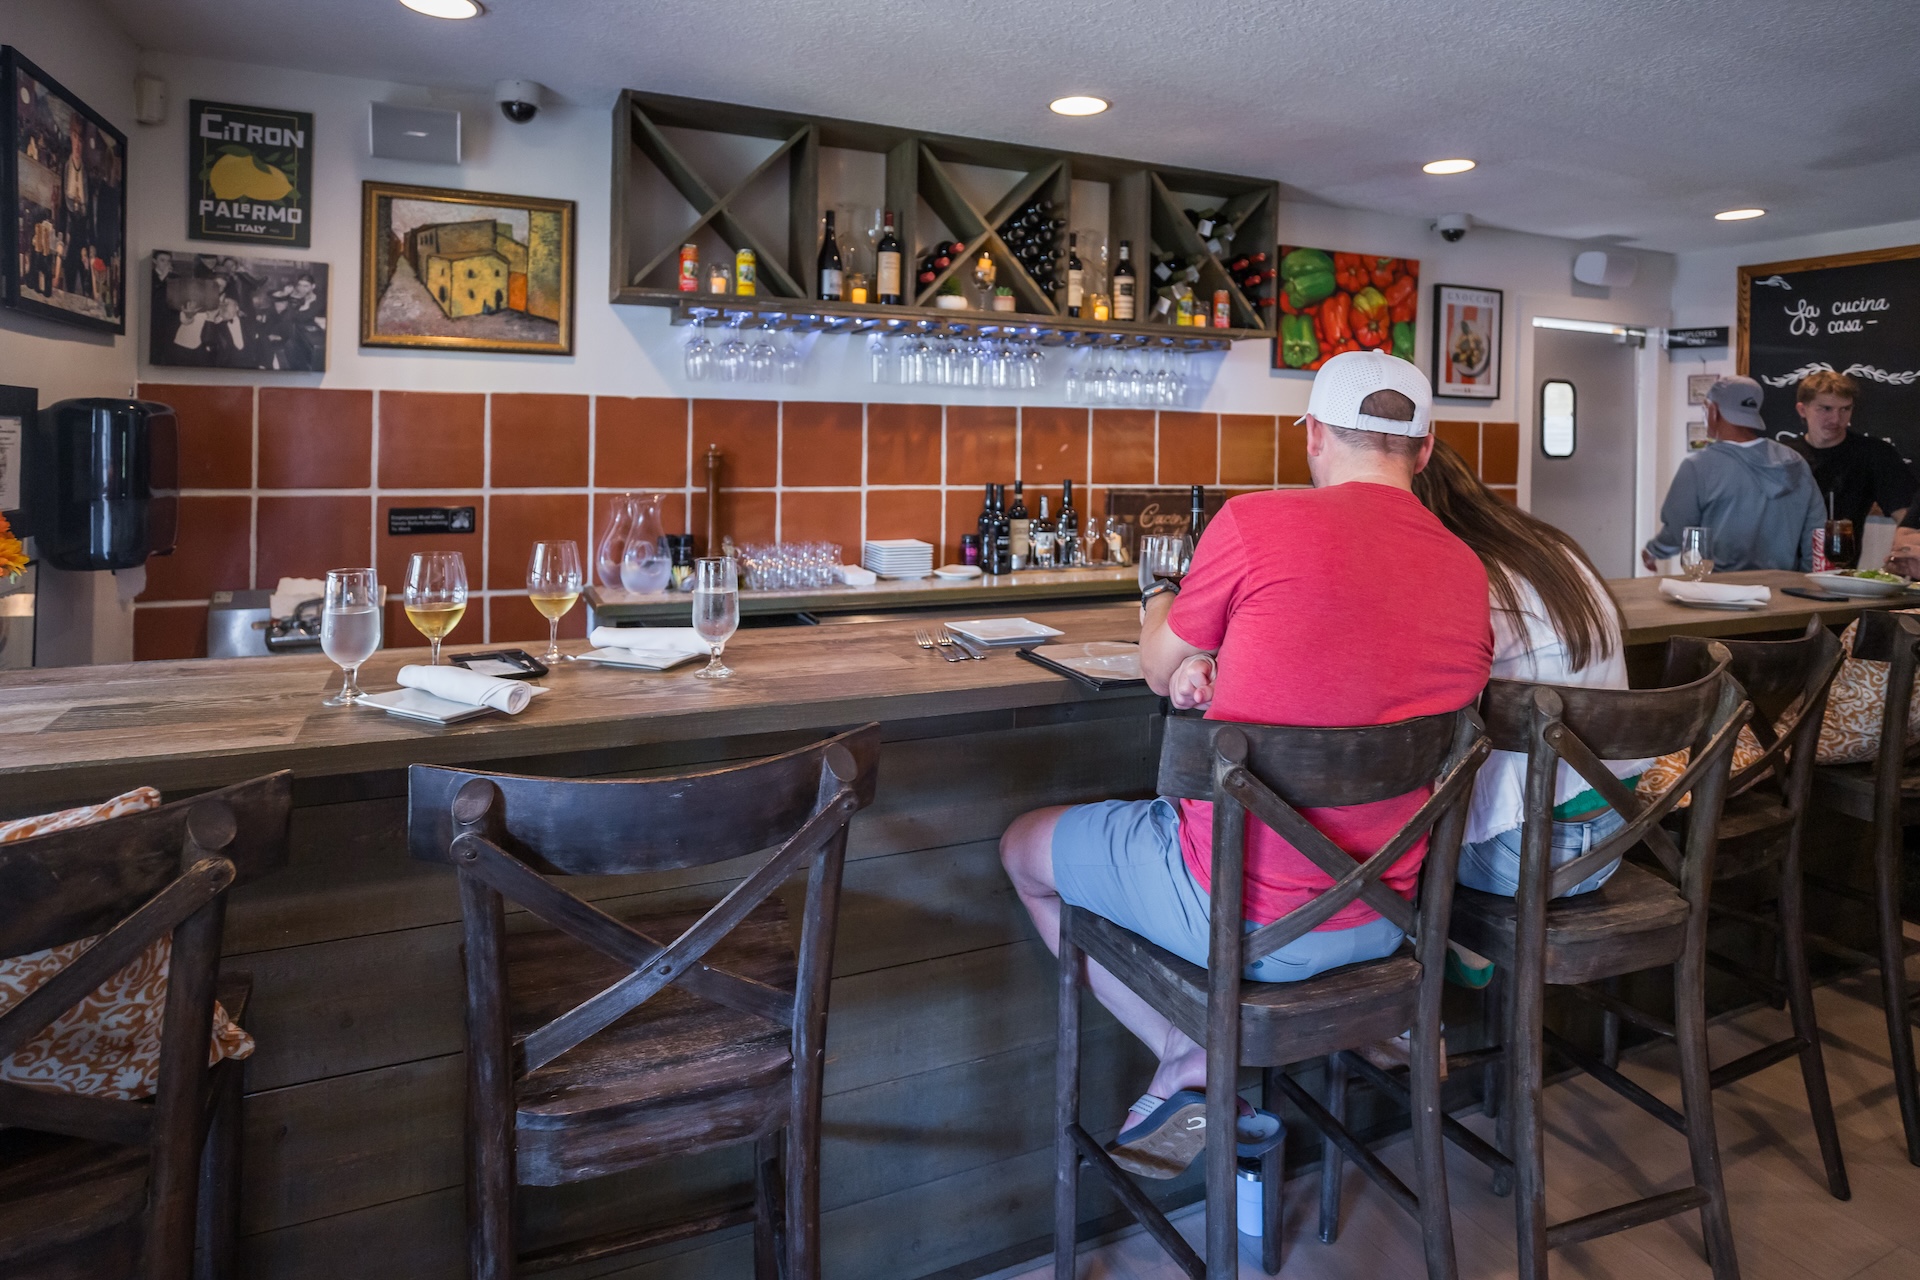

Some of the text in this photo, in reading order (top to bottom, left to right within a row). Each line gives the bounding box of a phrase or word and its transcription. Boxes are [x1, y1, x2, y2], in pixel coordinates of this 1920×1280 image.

[235, 223, 267, 233] ITALY
[1447, 292, 1494, 304] GNOCCHI
[1831, 296, 1890, 316] cucina
[1677, 329, 1718, 338] EMPLOYEES
[1687, 338, 1706, 346] ONLY
